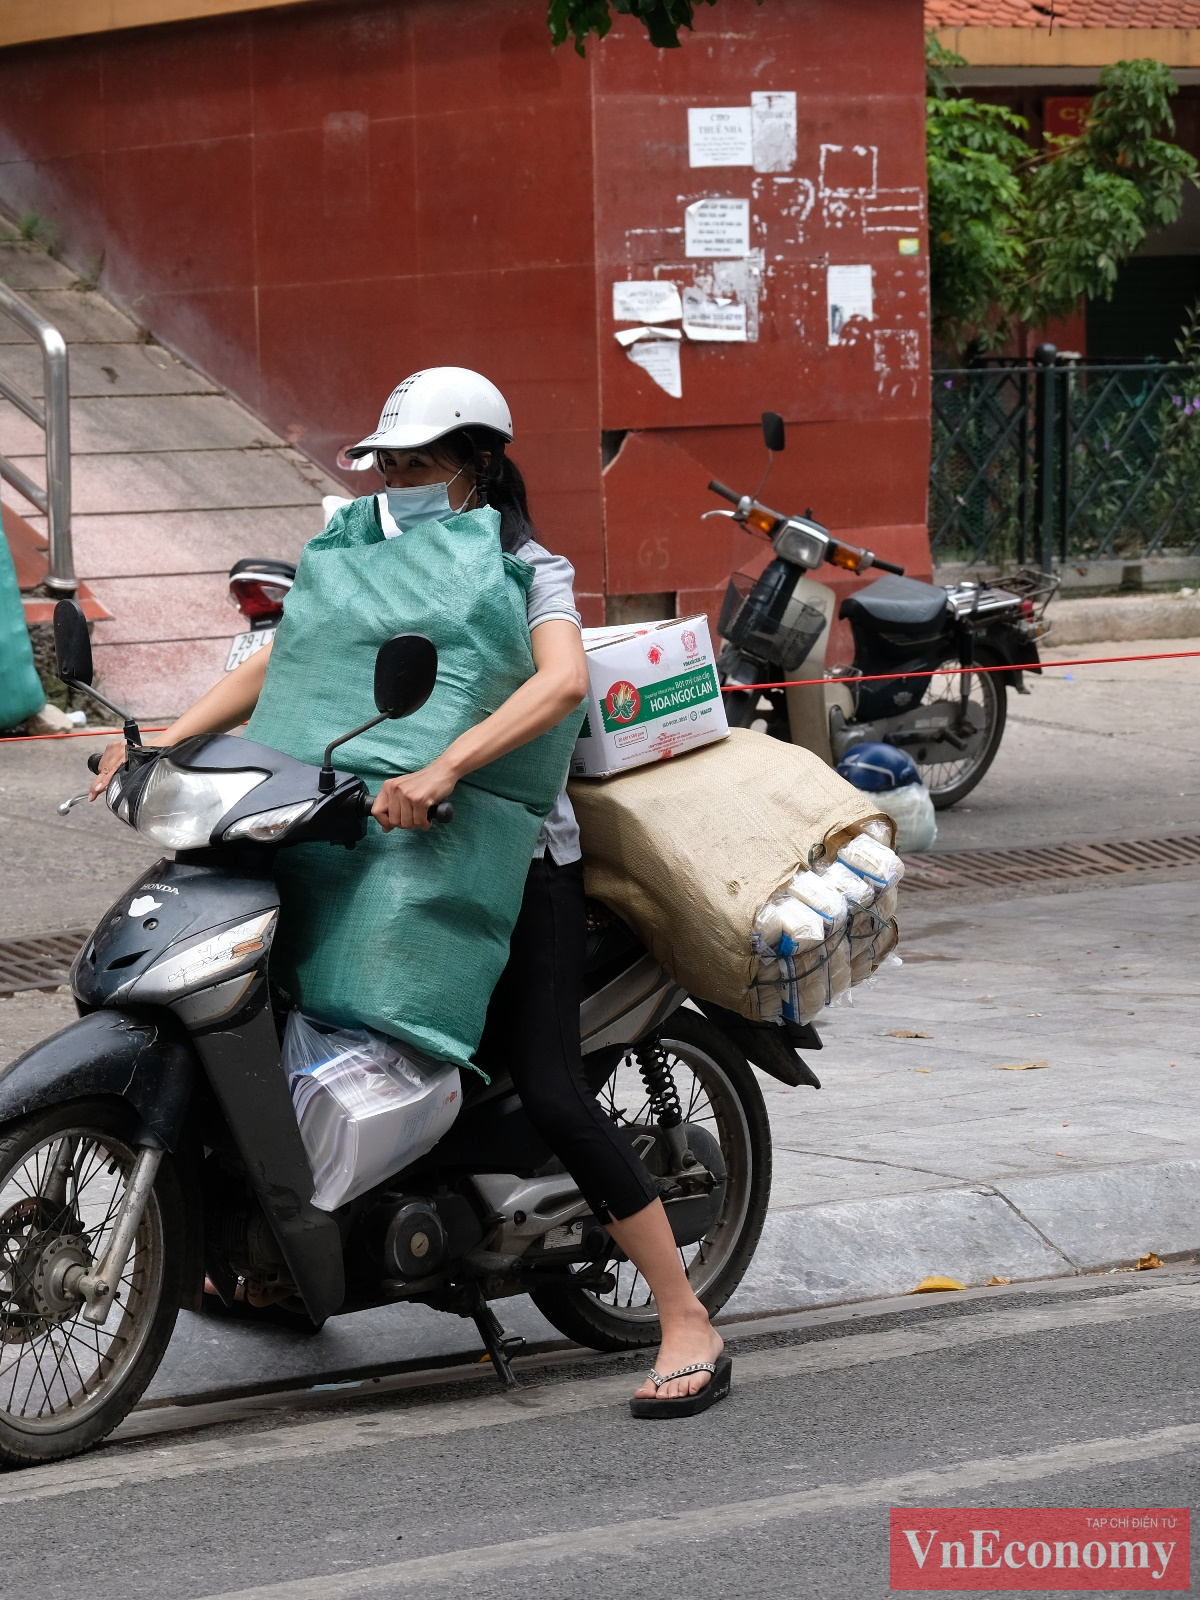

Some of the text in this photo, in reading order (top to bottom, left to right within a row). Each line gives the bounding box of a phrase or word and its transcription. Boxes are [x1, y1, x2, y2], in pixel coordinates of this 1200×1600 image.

[674, 680, 685, 689] Bột
[650, 680, 713, 712] HOA NGỌC LAN
[140, 883, 179, 895] HONDA
